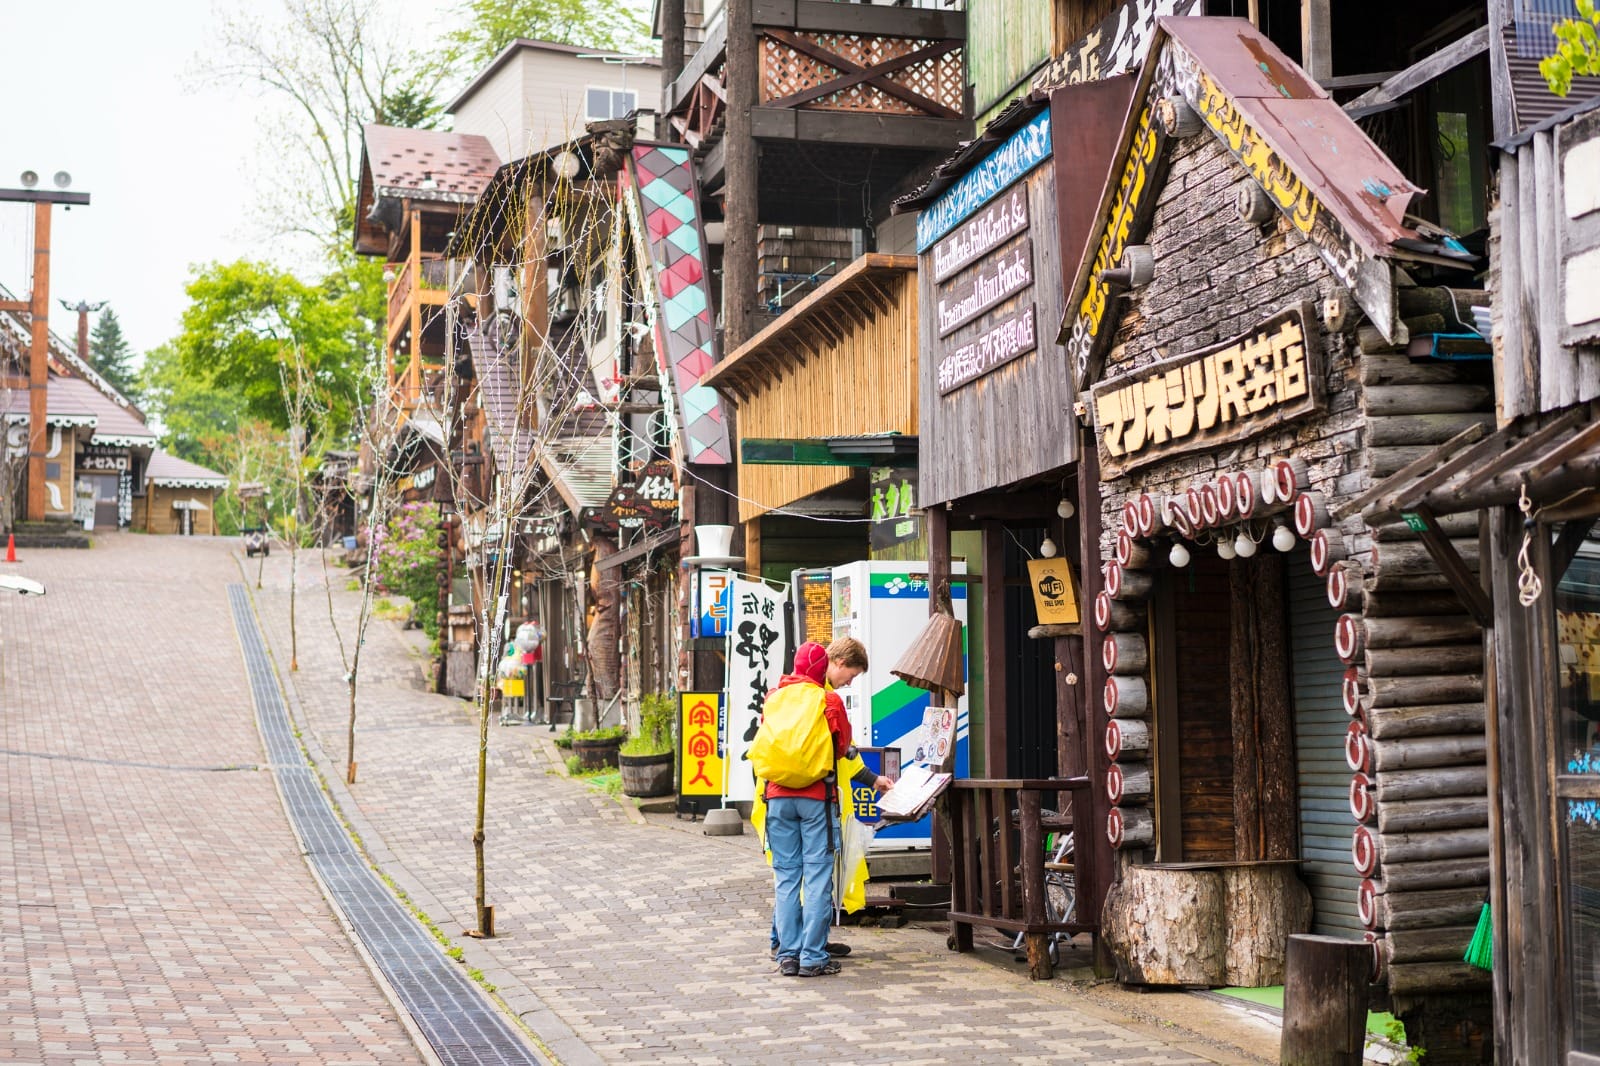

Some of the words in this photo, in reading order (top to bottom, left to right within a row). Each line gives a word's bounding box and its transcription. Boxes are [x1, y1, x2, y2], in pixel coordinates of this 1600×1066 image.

[1011, 193, 1026, 230] &
[938, 281, 978, 333] Traditional
[978, 274, 998, 308] Ainu
[1097, 320, 1306, 457] マツネシリ民芸店
[709, 576, 728, 634] コーヒー
